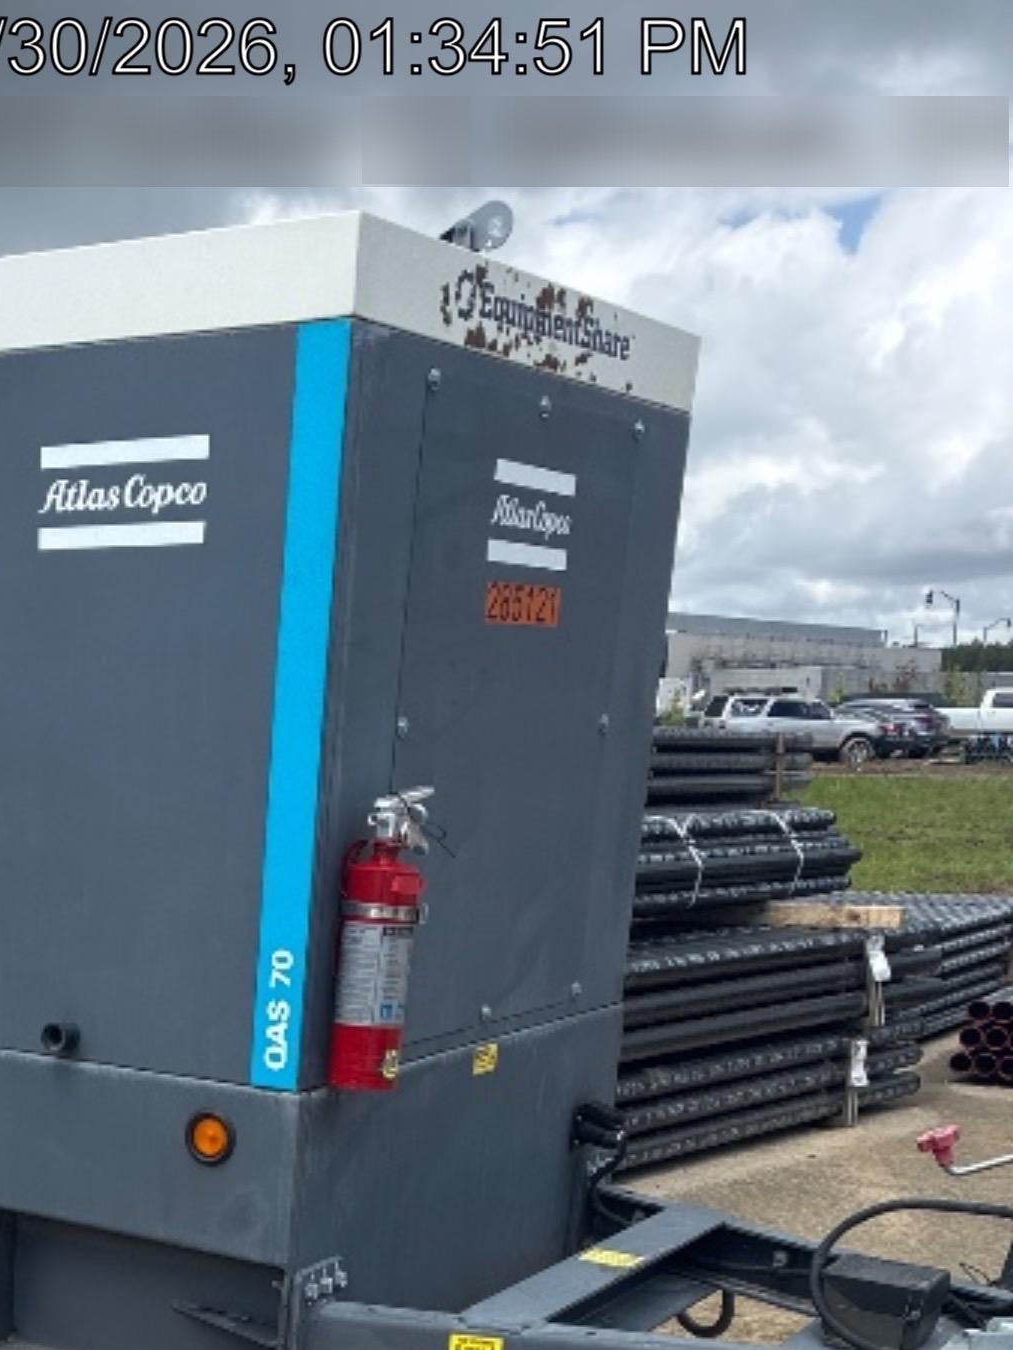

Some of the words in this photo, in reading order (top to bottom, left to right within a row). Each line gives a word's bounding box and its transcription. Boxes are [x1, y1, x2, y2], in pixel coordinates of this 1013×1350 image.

[38, 479, 120, 514] Atlas
[123, 472, 207, 514] Copco
[487, 581, 558, 622] 285121
[269, 949, 294, 988] 70
[264, 1000, 290, 1072] QAS
